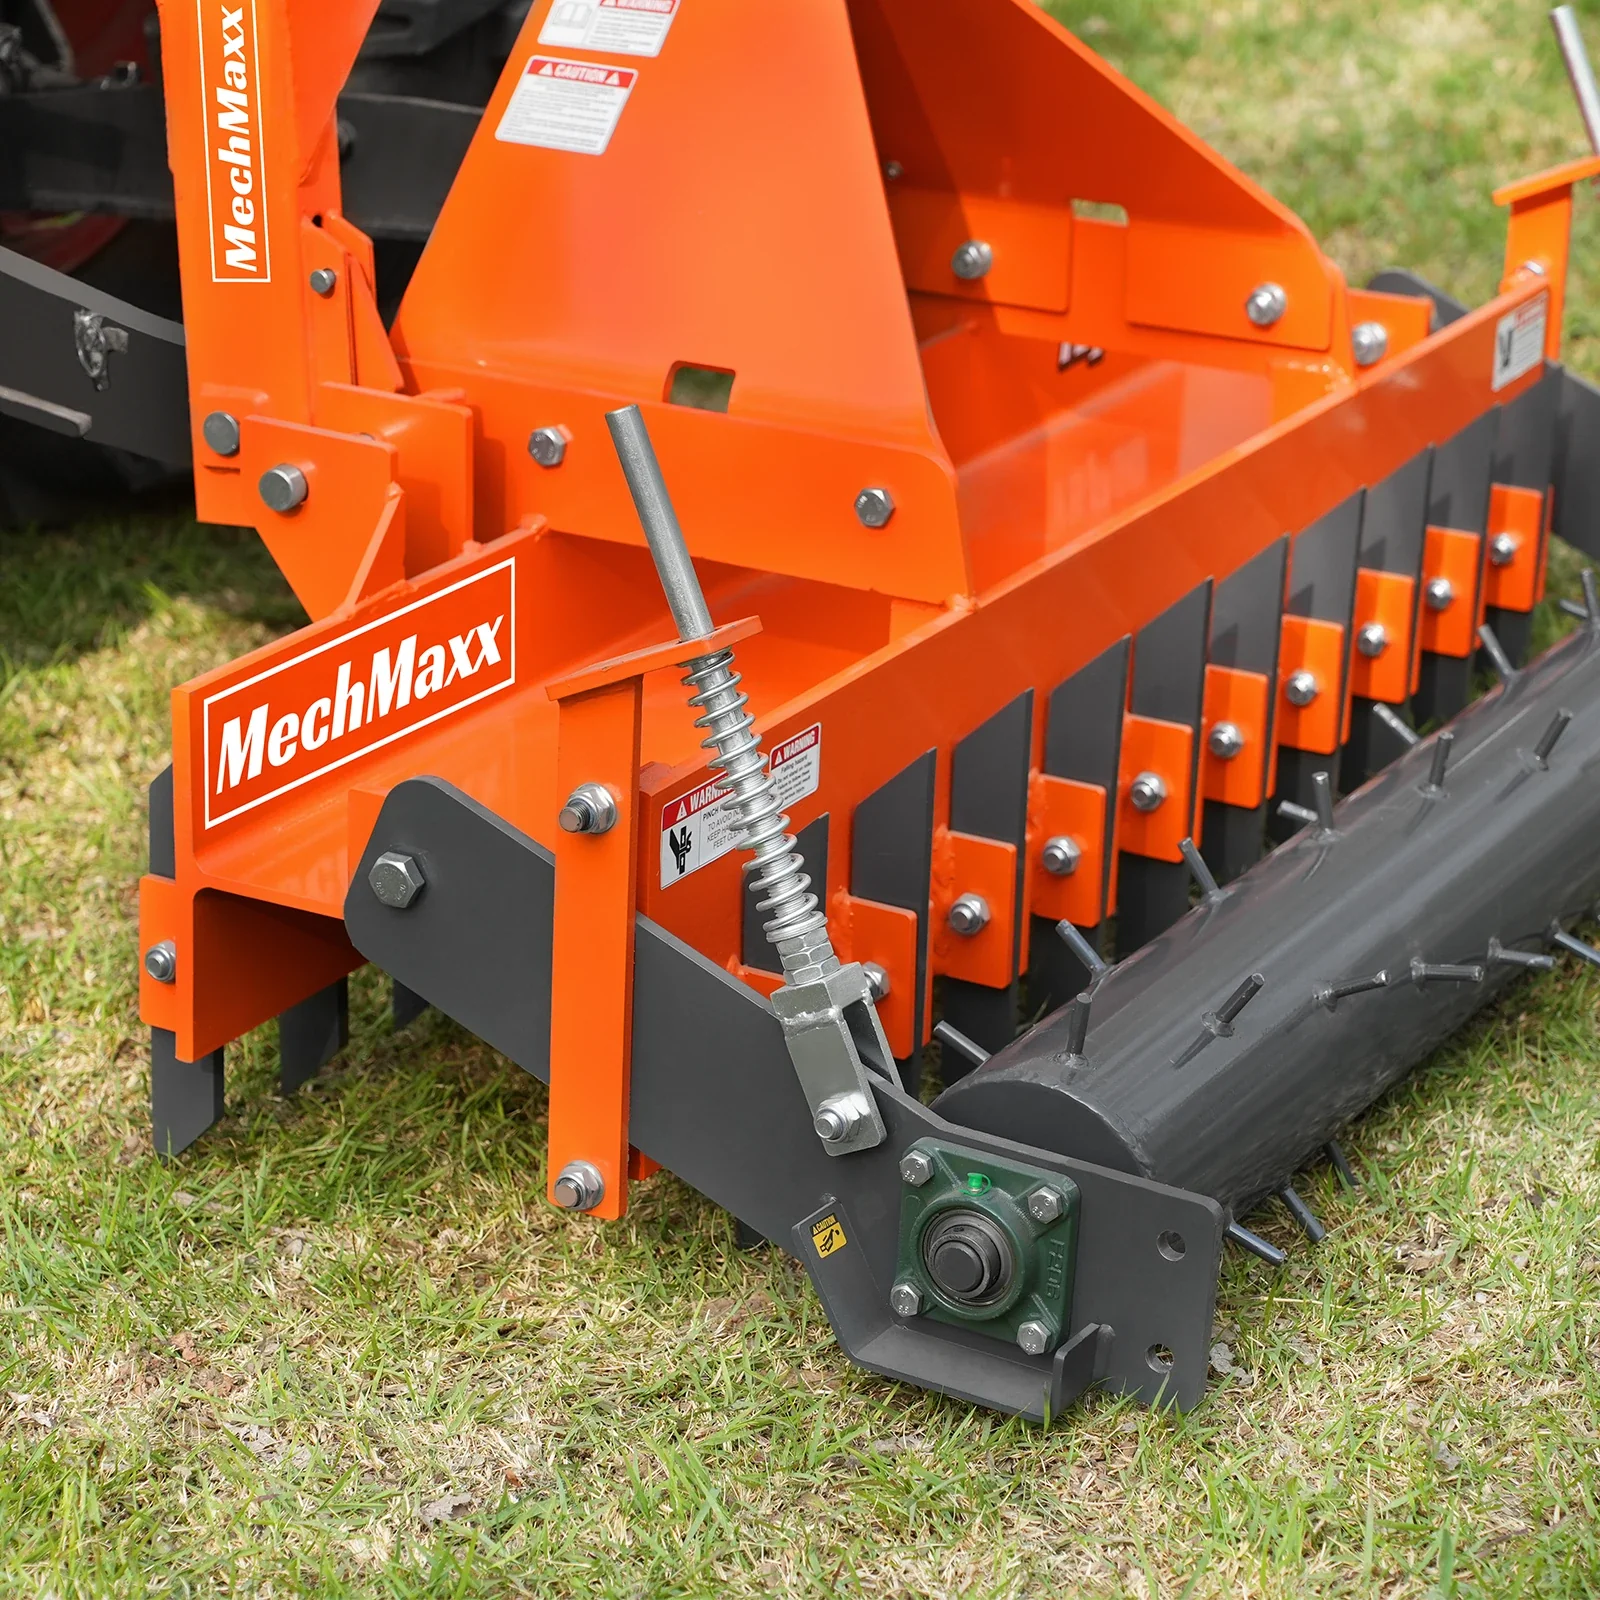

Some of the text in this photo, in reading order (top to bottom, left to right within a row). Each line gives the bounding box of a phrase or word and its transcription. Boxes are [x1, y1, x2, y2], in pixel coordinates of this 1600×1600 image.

[553, 63, 608, 83] CAUTION
[216, 4, 257, 273] MechMaxx
[216, 614, 504, 795] MechMaxx
[783, 729, 815, 760] WARNING
[690, 784, 734, 813] WARN
[703, 806, 719, 821] PINCH
[716, 812, 732, 827] AVOID
[707, 829, 721, 843] KEEP
[713, 835, 726, 849] FEET
[815, 1214, 836, 1231] CAUTION
